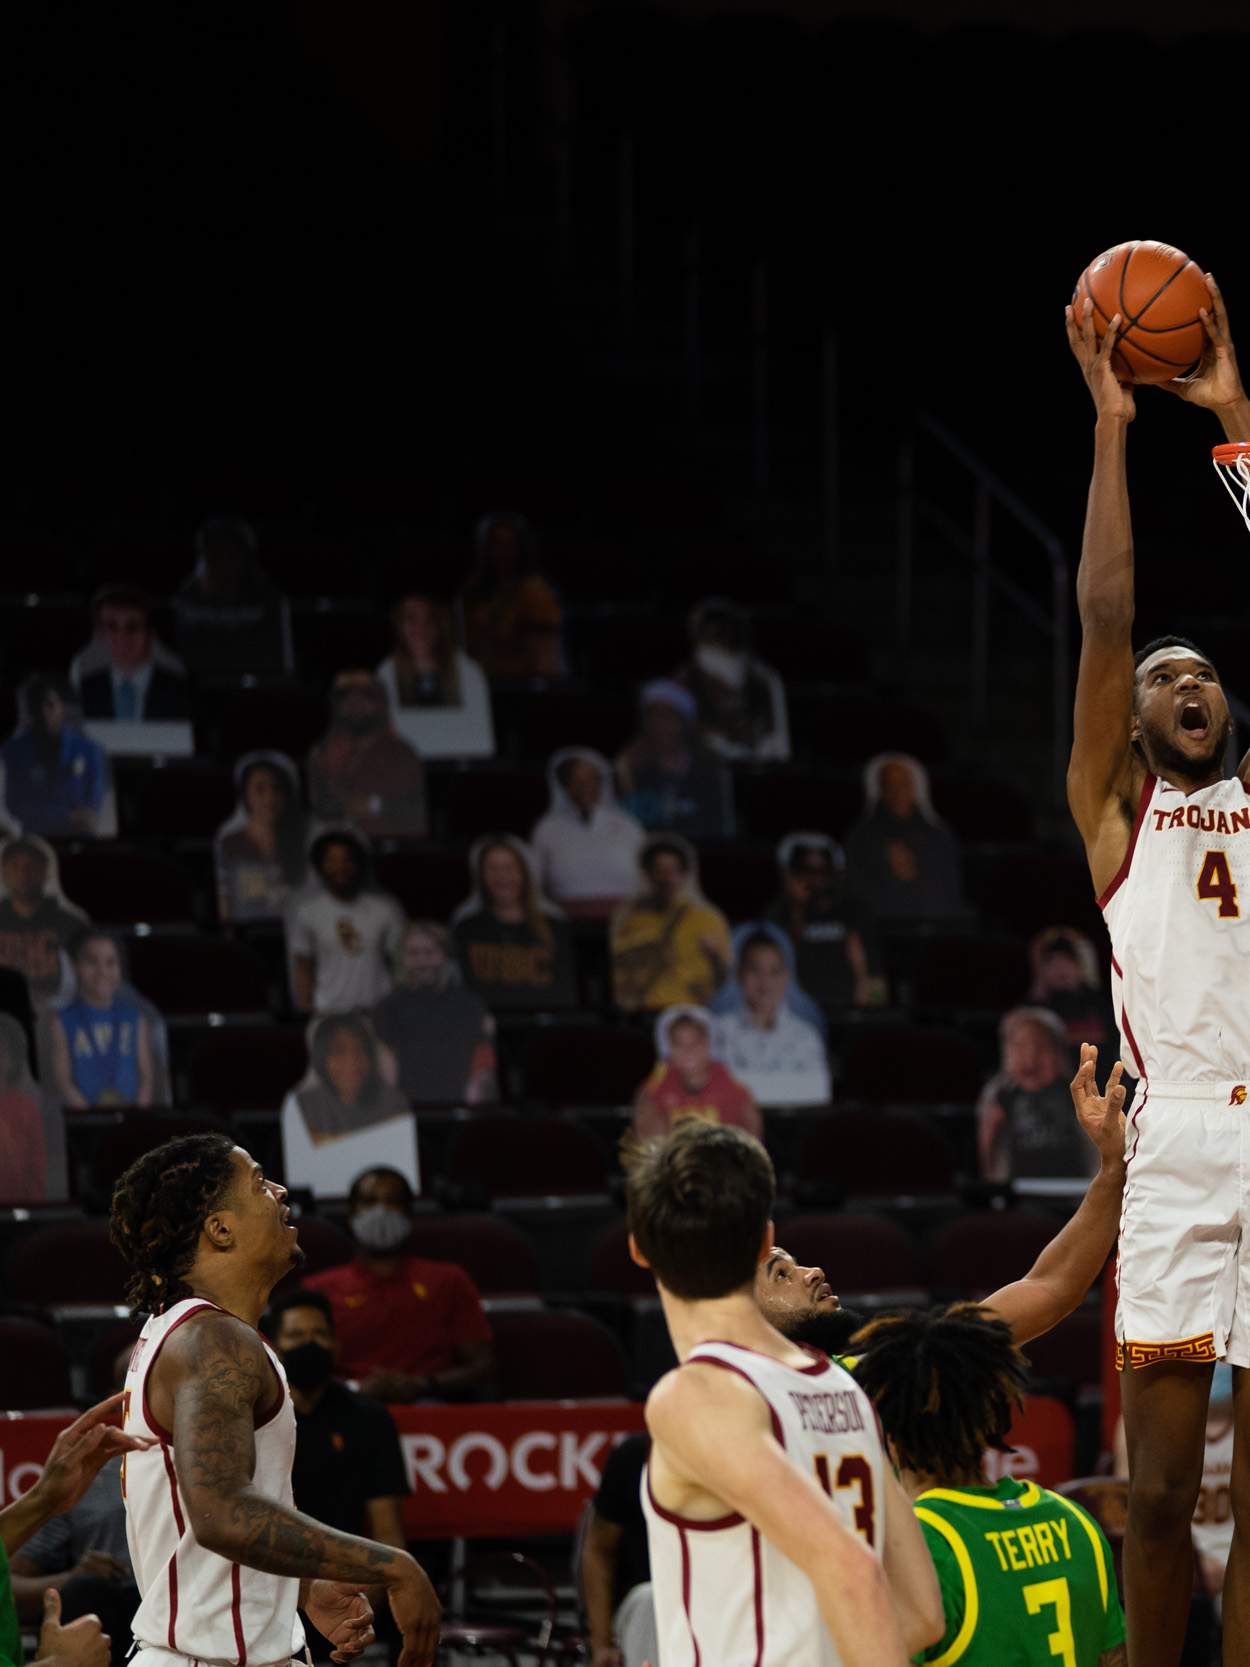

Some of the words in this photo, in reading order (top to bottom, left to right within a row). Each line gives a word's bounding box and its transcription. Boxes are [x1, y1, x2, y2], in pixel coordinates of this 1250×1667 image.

[1196, 850, 1241, 919] 4
[400, 1431, 628, 1493] ROCK
[984, 1517, 1072, 1571] TERRY
[1022, 1576, 1078, 1667] 3
